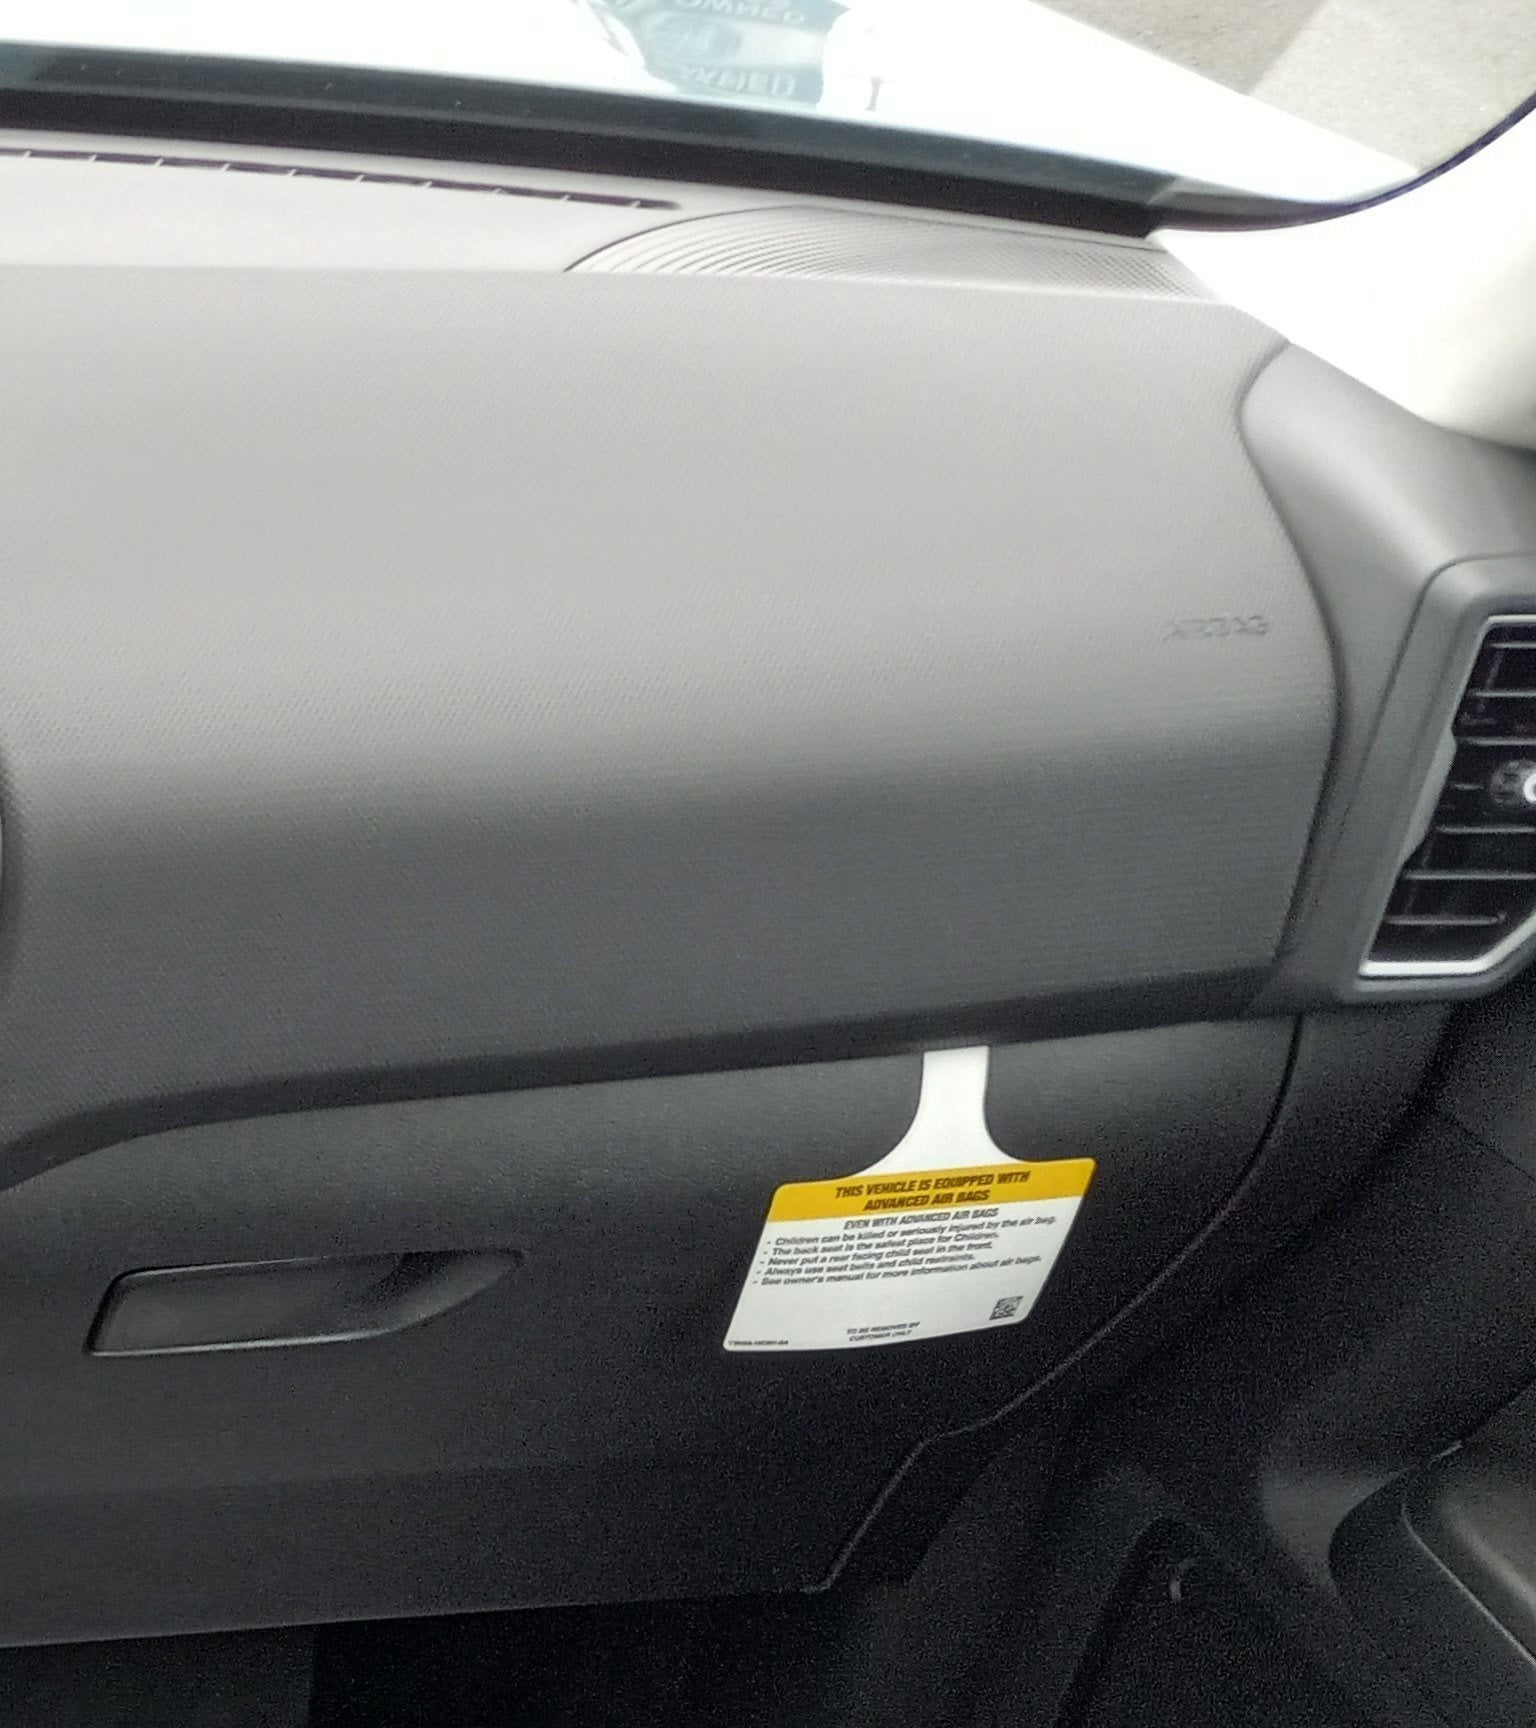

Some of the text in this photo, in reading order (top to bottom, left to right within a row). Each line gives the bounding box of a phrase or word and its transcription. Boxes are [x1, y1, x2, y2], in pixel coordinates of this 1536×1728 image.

[835, 1171, 1031, 1198] THIS VEHICLE IS EQUIPPED WITH
[863, 1190, 990, 1211] ADVANCED AIR BAGS
[844, 1207, 1000, 1230] EVEN WITH ADVANCED AIR BAGS
[775, 1236, 819, 1246] Children
[842, 1233, 855, 1242] be
[1001, 1218, 1018, 1227] the
[772, 1246, 791, 1255] The
[856, 1241, 873, 1250] the
[800, 1256, 819, 1266] put
